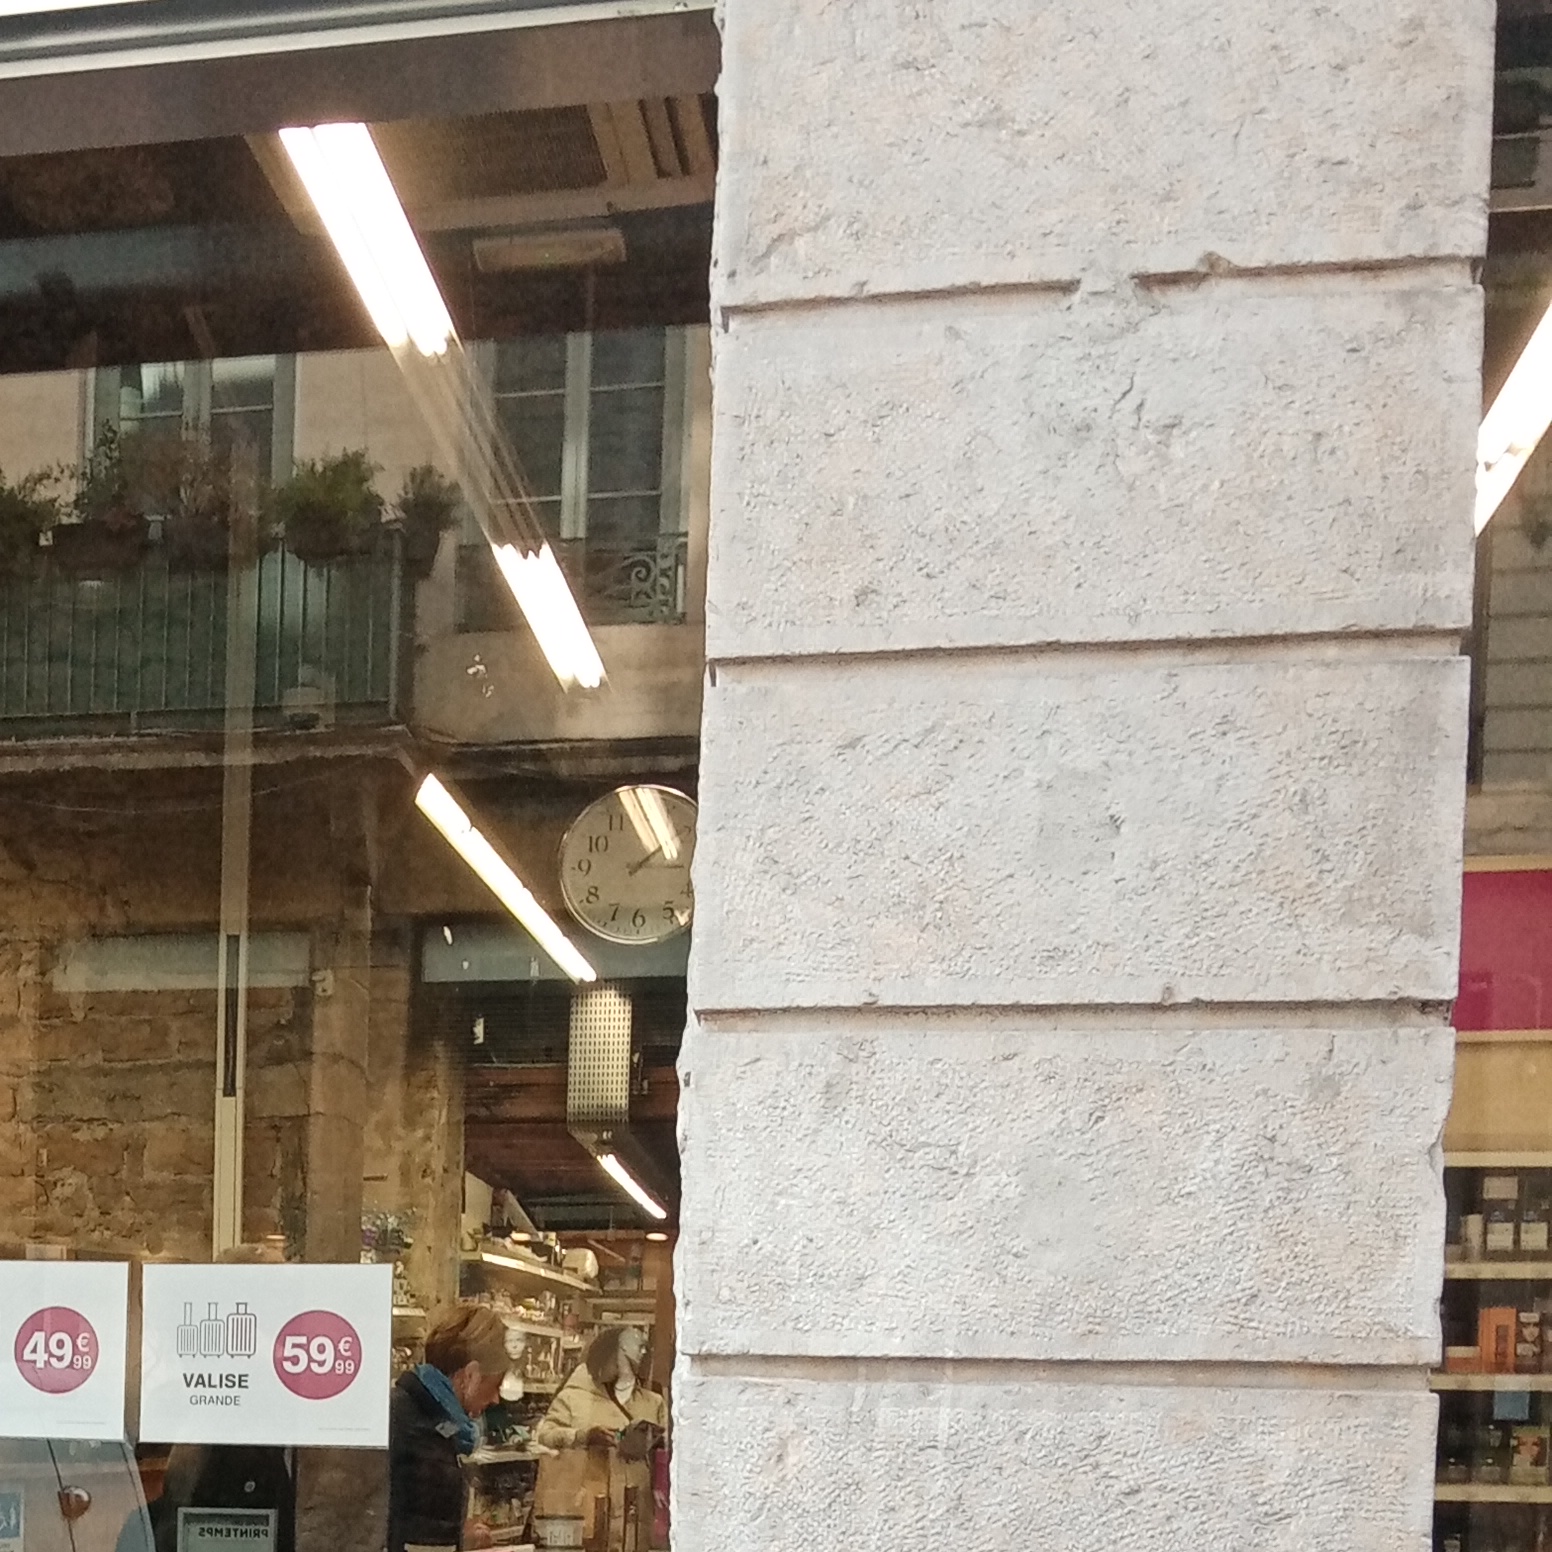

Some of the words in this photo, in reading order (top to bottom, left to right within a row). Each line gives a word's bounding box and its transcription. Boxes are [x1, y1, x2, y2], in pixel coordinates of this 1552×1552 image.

[608, 813, 625, 832] 11
[588, 834, 609, 854] 10
[577, 858, 592, 877] 9
[585, 885, 600, 905] 8
[608, 902, 620, 922] 7
[631, 908, 647, 929] 6
[662, 900, 675, 920] 5
[183, 1373, 250, 1390] VALISE
[189, 1395, 241, 1407] GRANDE
